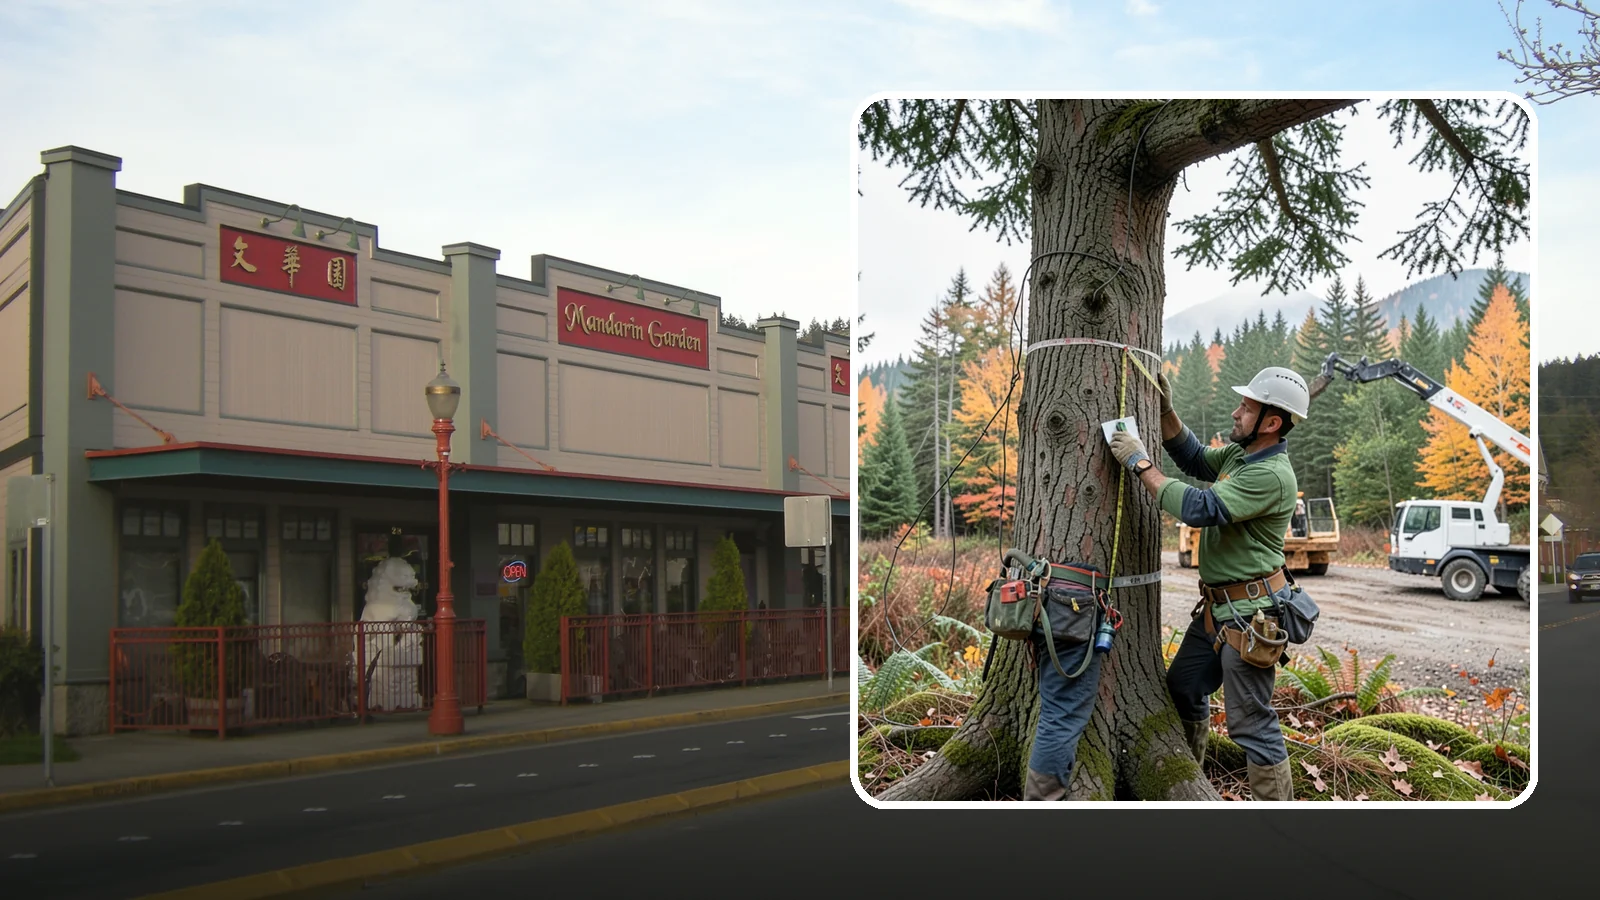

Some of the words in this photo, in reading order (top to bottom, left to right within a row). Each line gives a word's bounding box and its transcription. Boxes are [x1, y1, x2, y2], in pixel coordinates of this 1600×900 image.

[230, 236, 347, 292] 文華園
[564, 302, 644, 341] Mandarin
[647, 320, 702, 352] Garden
[503, 565, 527, 578] OPEN
